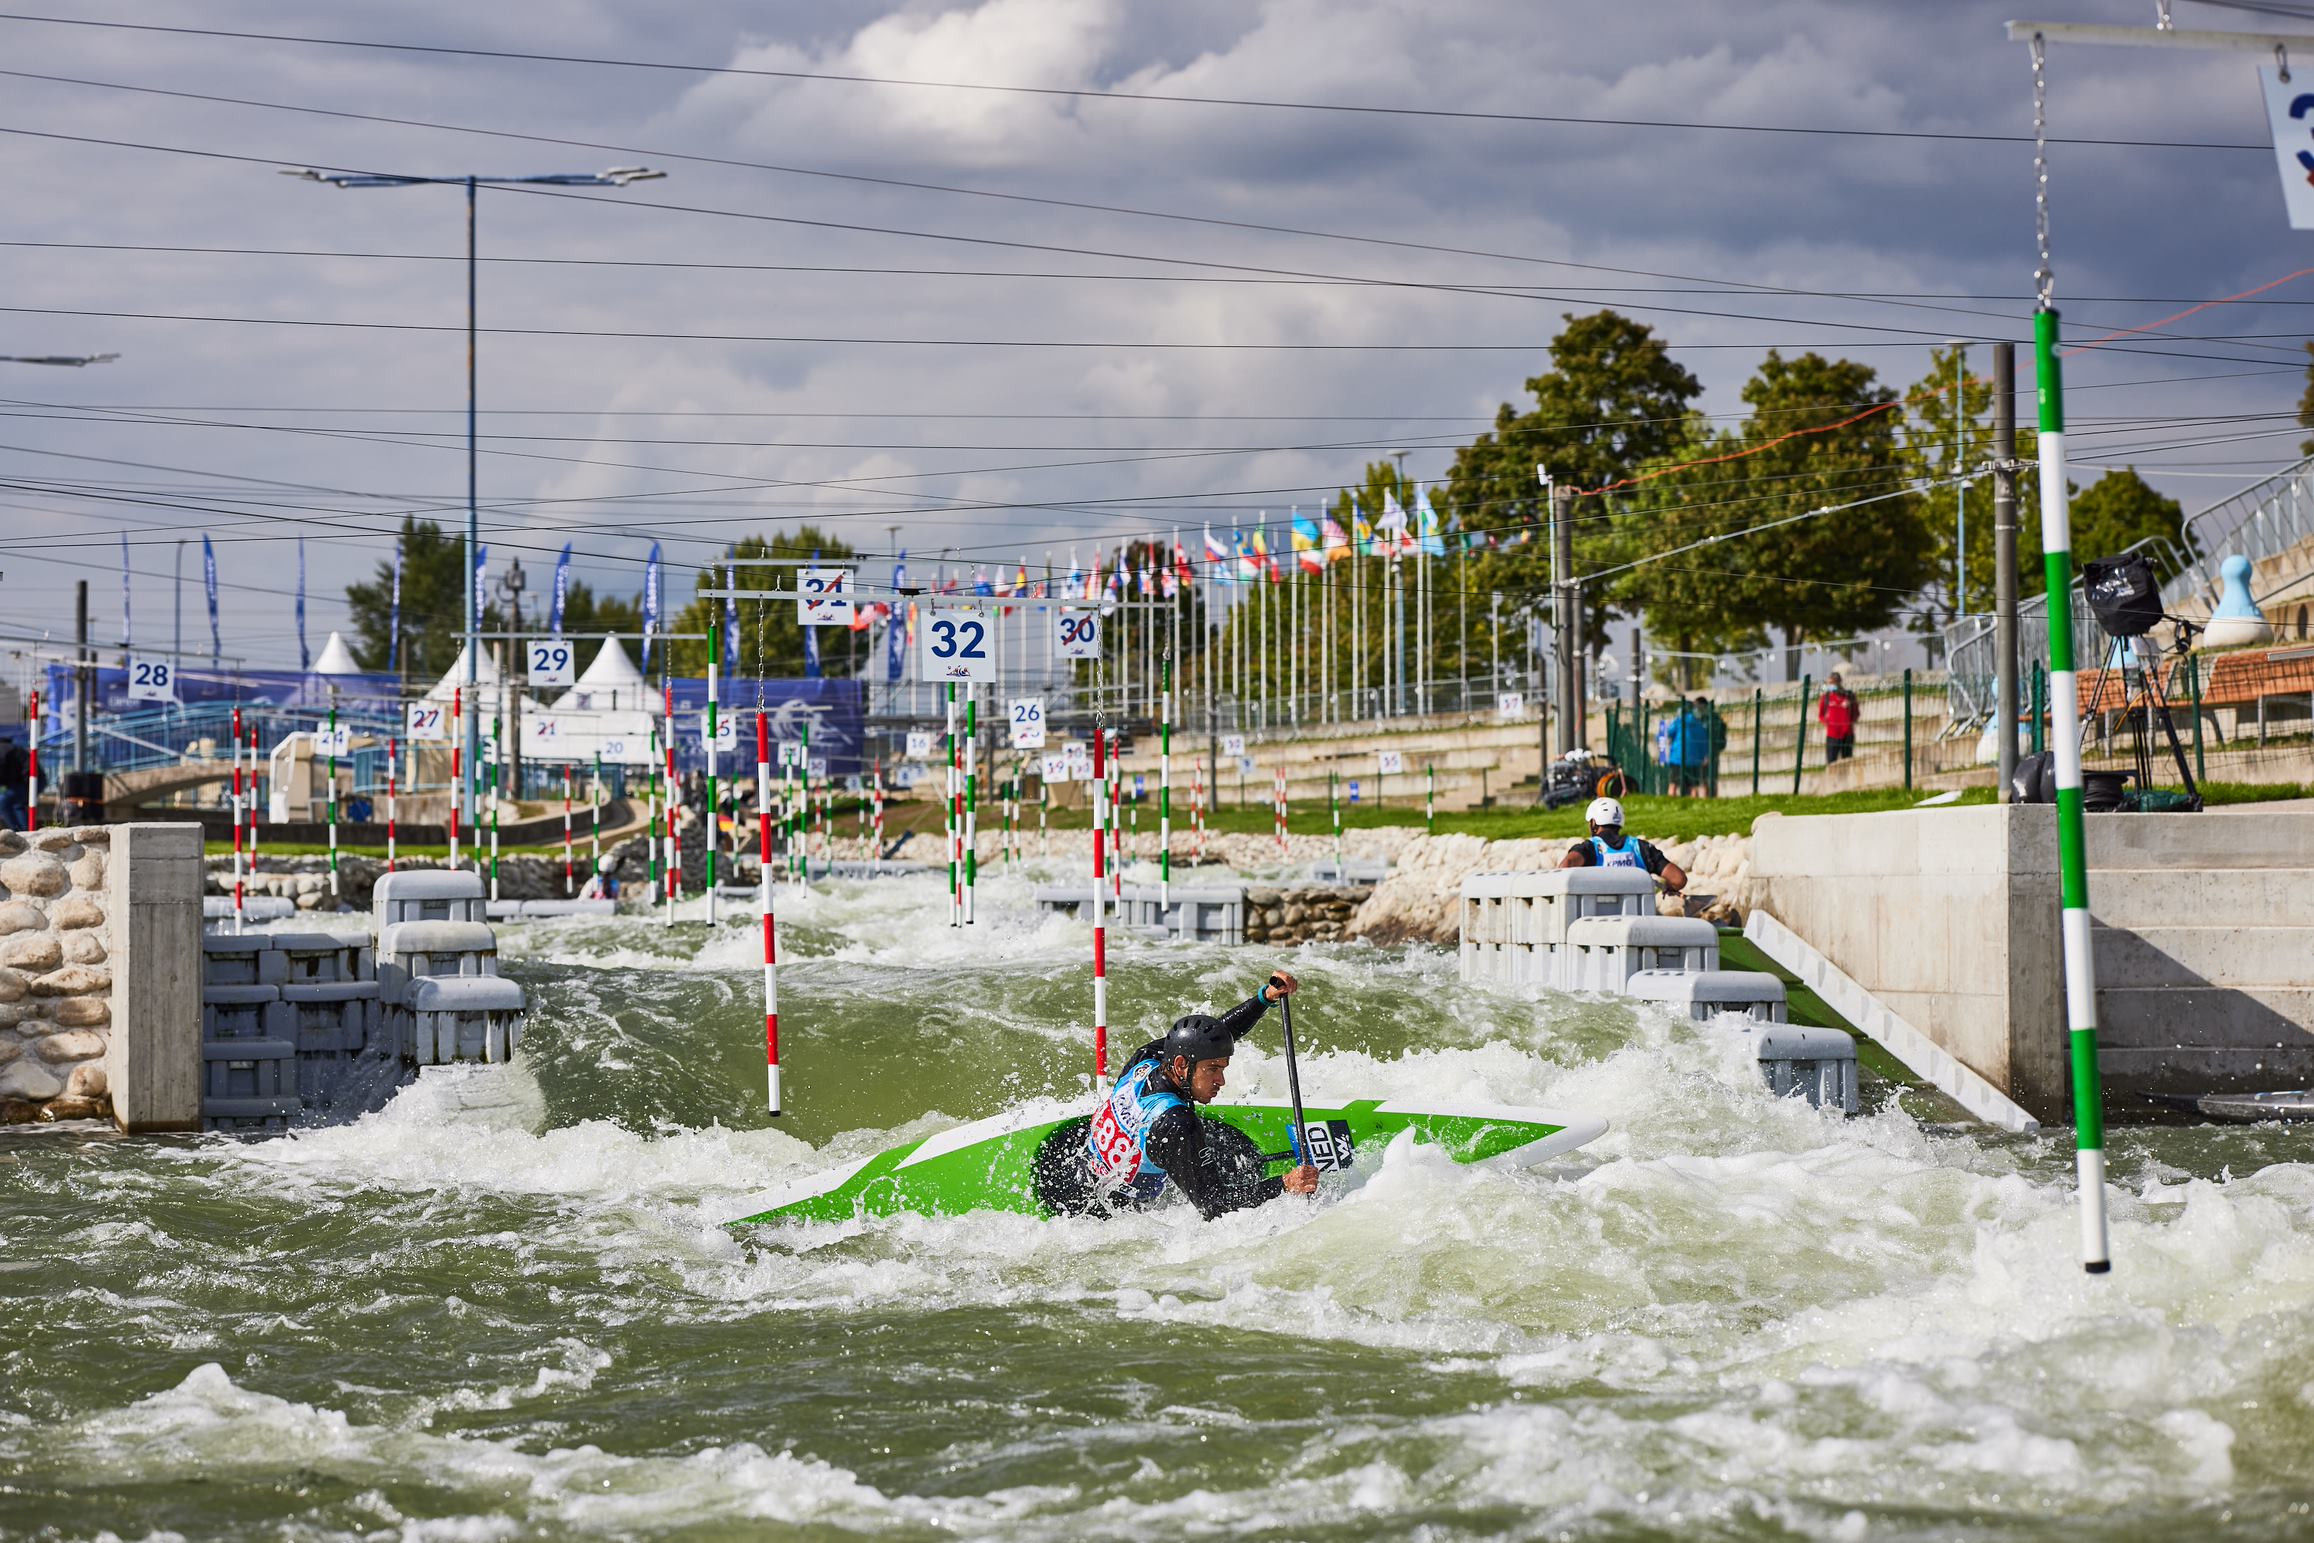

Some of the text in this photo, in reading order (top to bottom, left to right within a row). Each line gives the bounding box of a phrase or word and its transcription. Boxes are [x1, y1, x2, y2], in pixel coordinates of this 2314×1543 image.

[931, 620, 986, 659] 32
[1060, 618, 1095, 642] 30
[534, 648, 568, 671] 29
[135, 663, 168, 687] 28
[413, 709, 439, 728] 27
[1015, 704, 1040, 722] 26
[606, 742, 624, 754] 20
